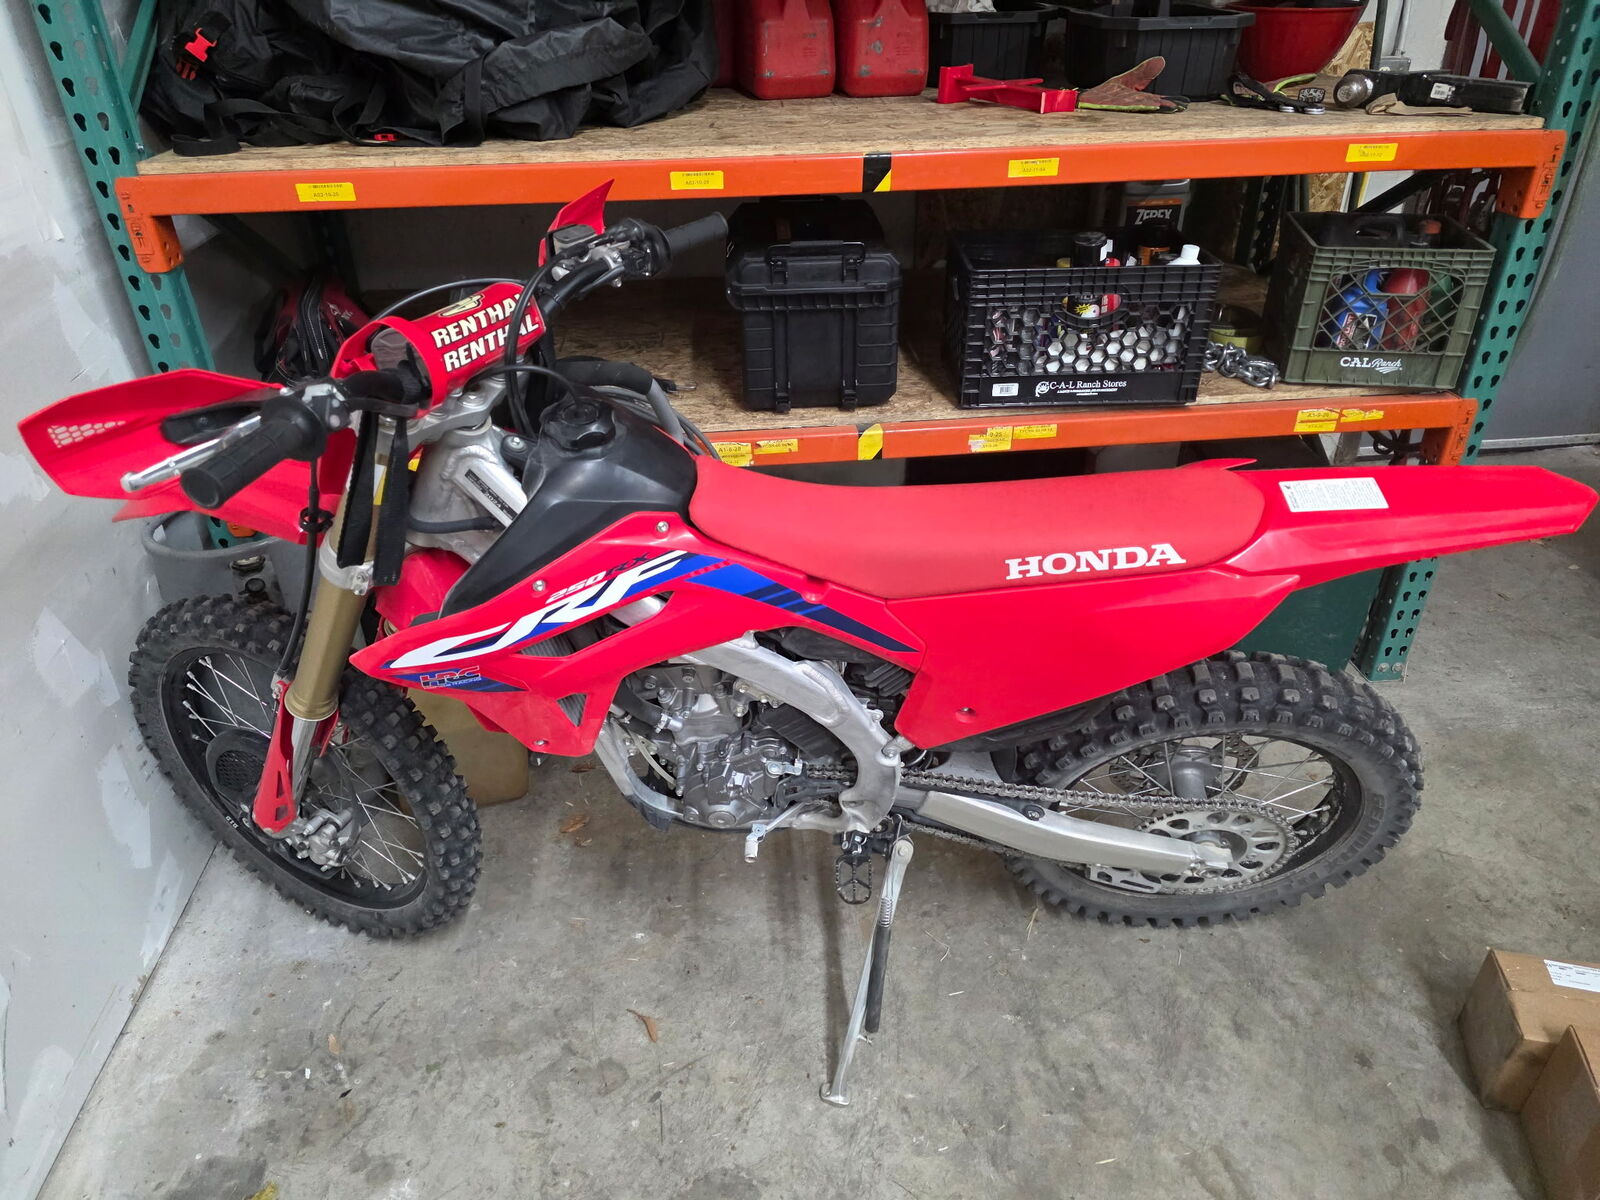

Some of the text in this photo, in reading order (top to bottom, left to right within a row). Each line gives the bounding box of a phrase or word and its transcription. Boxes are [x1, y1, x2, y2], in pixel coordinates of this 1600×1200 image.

[431, 293, 531, 349] RENTHA
[1340, 356, 1402, 368] CAL Ranch
[1049, 379, 1127, 390] C-A-L Ranch Stores
[1005, 543, 1187, 580] HONDA
[389, 549, 688, 669] CRF
[419, 665, 481, 690] HRC
